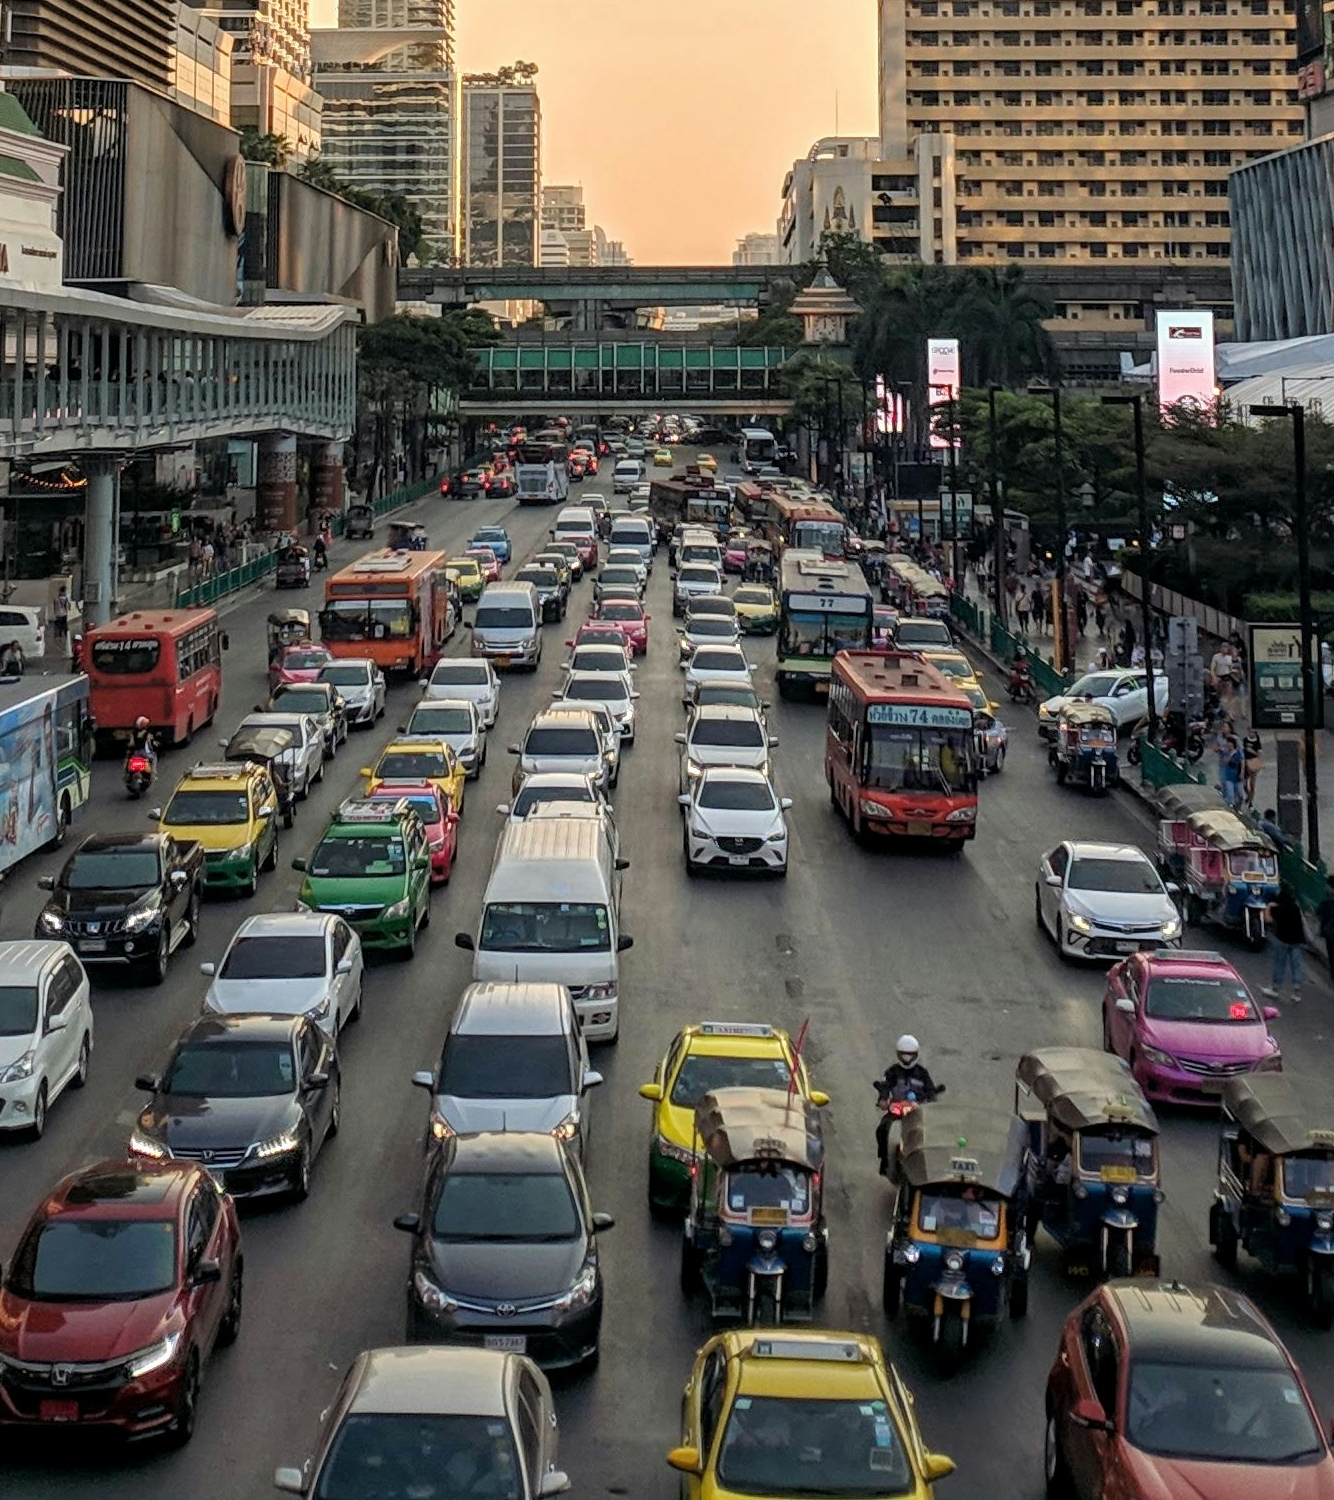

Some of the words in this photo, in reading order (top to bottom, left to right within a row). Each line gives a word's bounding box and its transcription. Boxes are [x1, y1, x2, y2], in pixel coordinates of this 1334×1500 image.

[819, 598, 835, 608] 77
[910, 709, 929, 724] 74
[952, 1160, 975, 1171] TAXI
